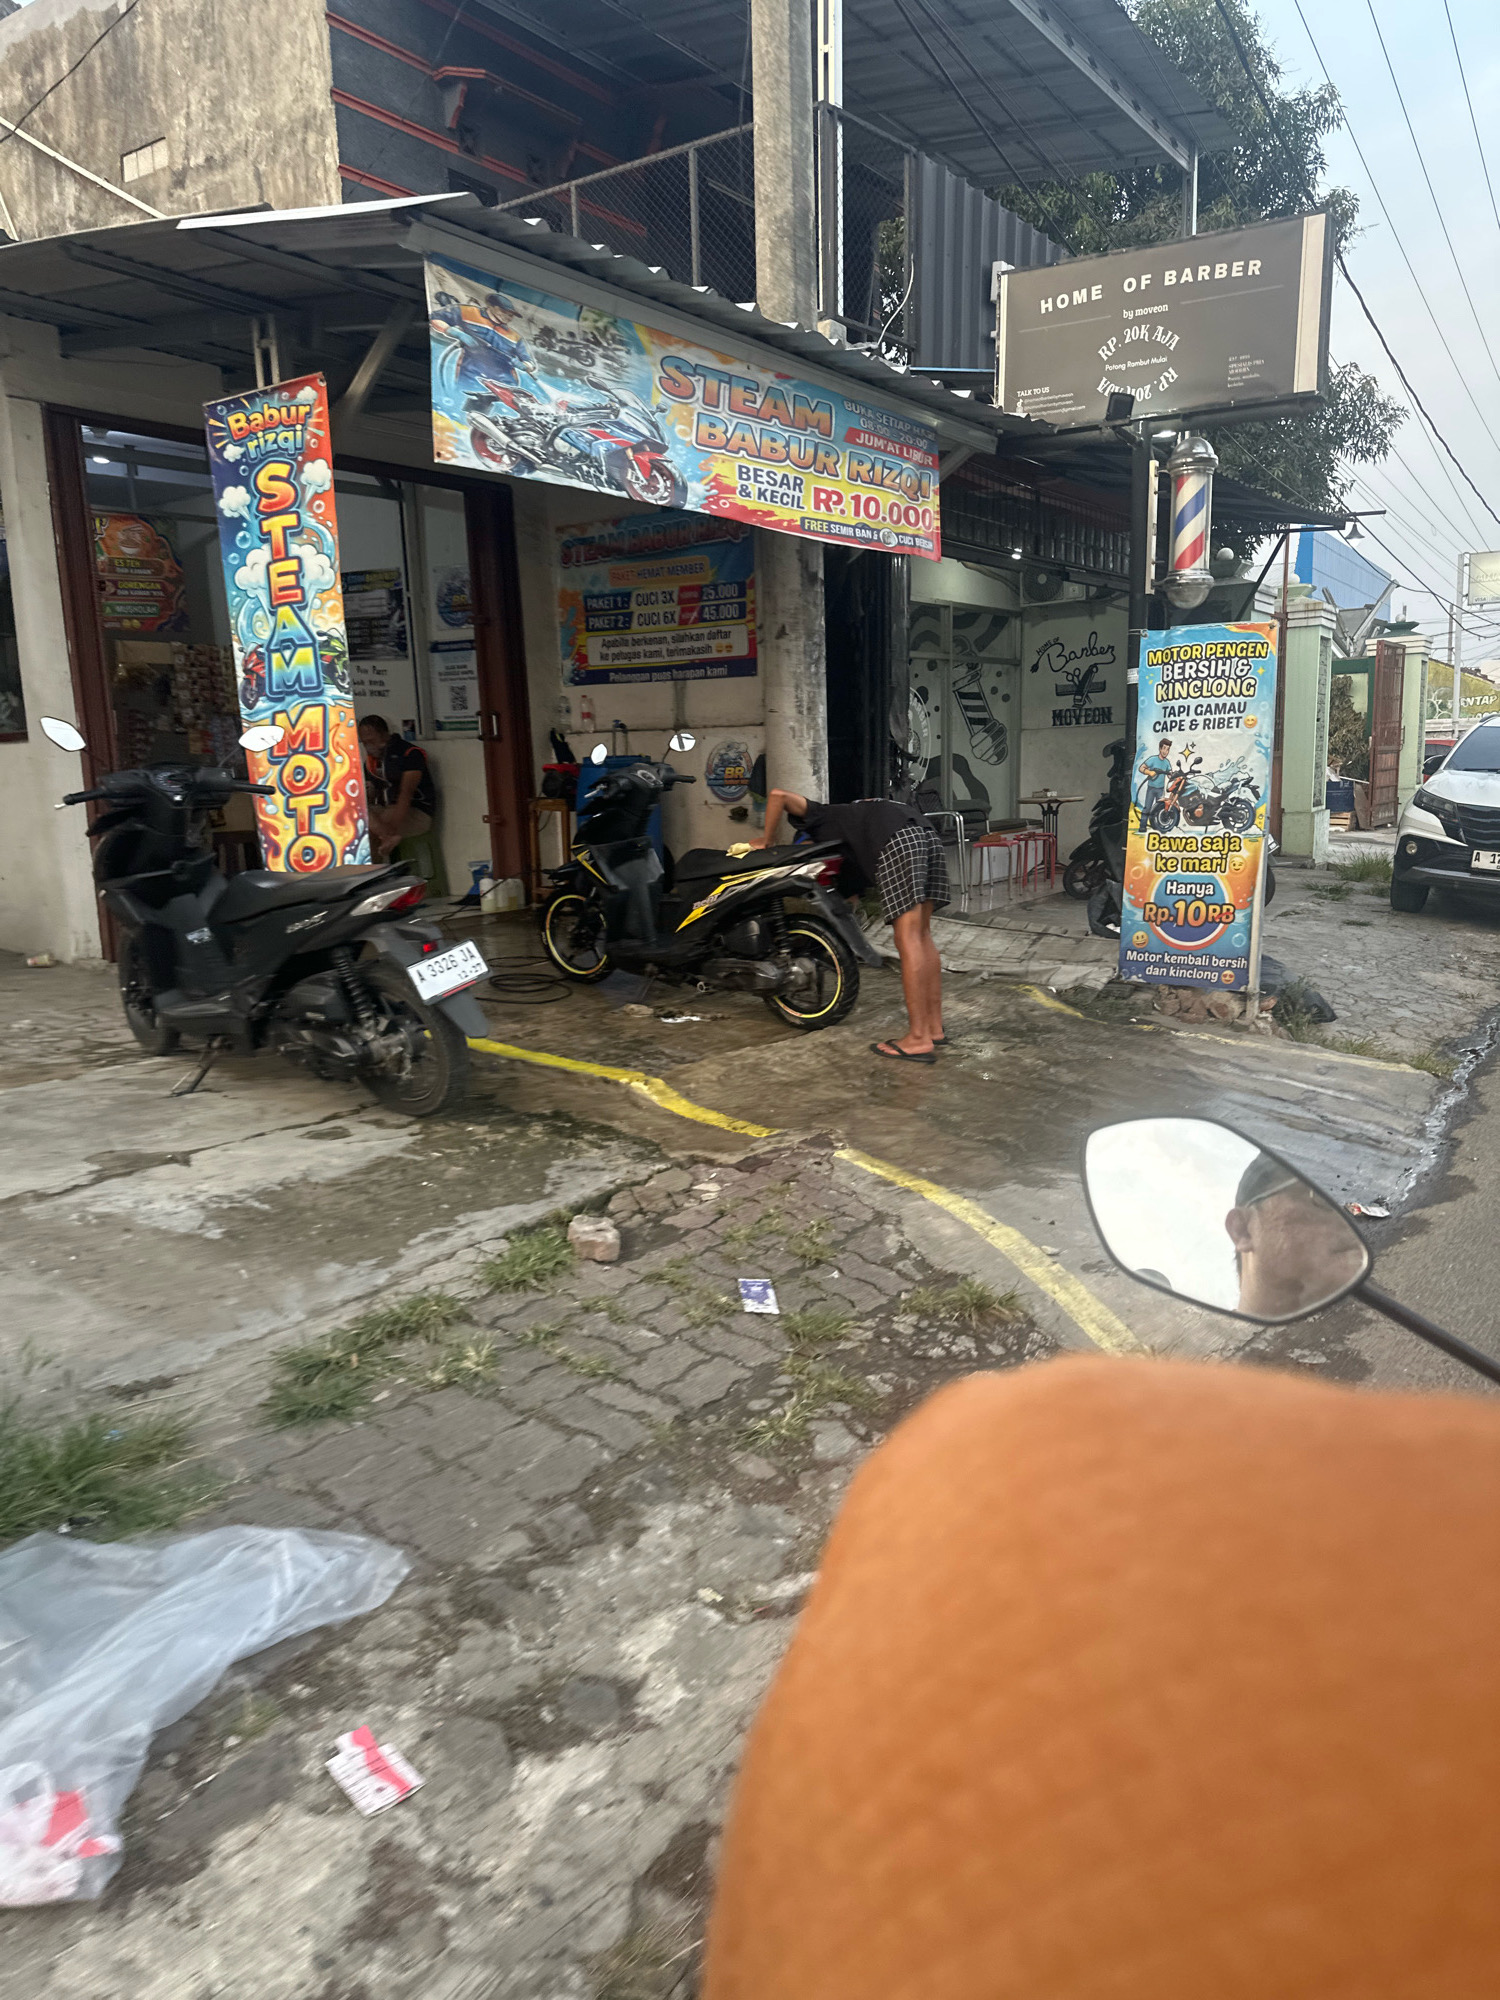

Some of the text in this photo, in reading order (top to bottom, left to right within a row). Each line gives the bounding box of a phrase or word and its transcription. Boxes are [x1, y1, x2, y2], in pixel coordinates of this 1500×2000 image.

[1040, 259, 1263, 315] HOME OF BARBER
[1123, 304, 1169, 320] by moveon
[1097, 324, 1181, 361] RP. 20K AJA
[1105, 356, 1168, 371] Potong Rambut Mulai
[658, 354, 835, 439] STEAM
[1016, 389, 1032, 398] TALK
[1042, 386, 1050, 394] US
[226, 403, 311, 441] Babur
[843, 400, 874, 418] BUKA
[876, 412, 911, 432] SETIAP
[246, 424, 304, 458] rizqi
[855, 432, 933, 466] JUM'AT LIBUR
[695, 411, 933, 501] BABUR RIZQI
[737, 464, 805, 493] BESAR
[738, 484, 806, 510] & KECIL
[804, 519, 829, 533] FREE
[830, 523, 854, 537] SEMIR
[855, 527, 872, 539] BAN
[873, 531, 878, 540] &
[898, 534, 914, 546] CUCI
[254, 461, 322, 695] STEAM
[637, 567, 665, 579] HEMAT
[667, 562, 705, 575] MEMBER
[586, 596, 614, 610] PAKET
[635, 593, 659, 607] CUCI
[661, 590, 675, 604] 3X
[702, 584, 739, 600] 25.000
[588, 616, 616, 630] PAKET
[637, 613, 660, 627] CUCI
[663, 611, 677, 624] 6X
[702, 603, 739, 620] 45.000
[599, 651, 609, 661] ke
[1147, 641, 1269, 667] MOTOR PENGEN
[706, 664, 728, 677] kami
[1162, 658, 1232, 682] BERSIH
[1234, 658, 1252, 677] &
[1156, 678, 1257, 703] KINCLONG
[1051, 706, 1114, 727] MOVEON
[1162, 701, 1247, 719] TAPI GAMAU
[1152, 716, 1243, 733] CAPE & RIBET
[716, 766, 746, 779] SBR
[270, 702, 335, 873] MOTO
[1147, 832, 1242, 855] Bawa saja
[1155, 853, 1228, 873] ke mari
[1473, 851, 1481, 863] A
[1166, 881, 1215, 898] Hanya
[416, 946, 477, 984] A 3326 JA
[1126, 950, 1248, 969] Motor kembali bersih
[1145, 965, 1219, 983] dan kinclong
